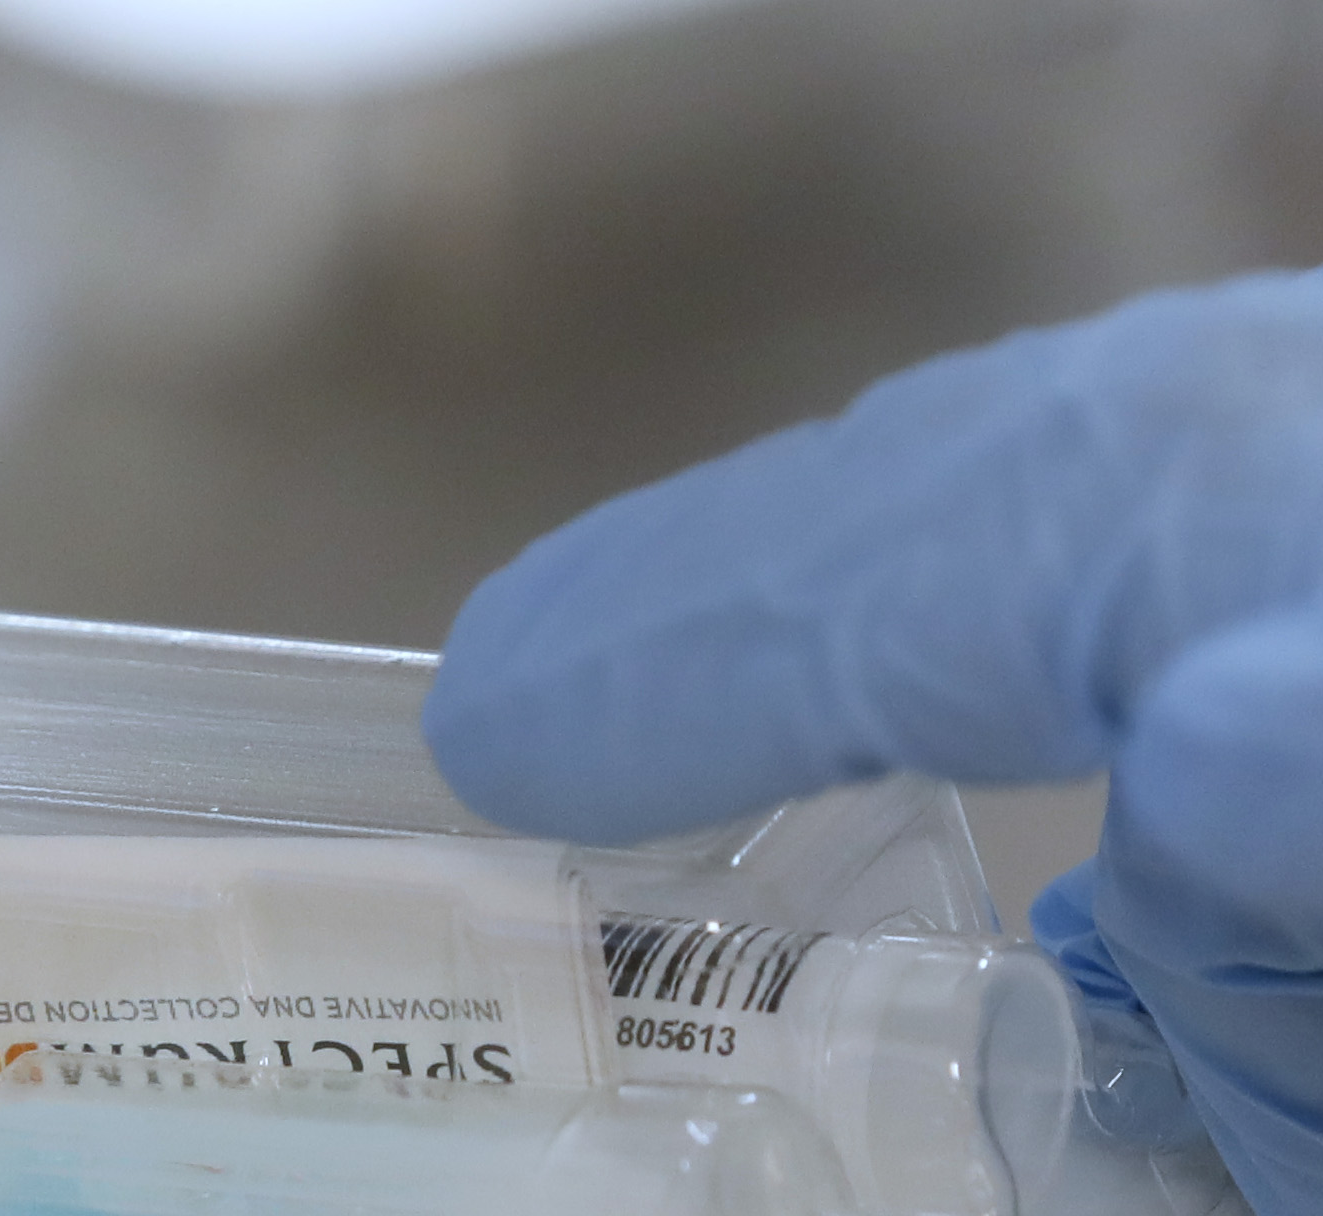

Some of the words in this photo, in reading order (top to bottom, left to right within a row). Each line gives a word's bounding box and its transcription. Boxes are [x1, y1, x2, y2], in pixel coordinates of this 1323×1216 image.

[45, 997, 240, 1022] COLLECTION
[248, 995, 315, 1018] DNA
[322, 997, 503, 1023] INNOVATIVE
[615, 1016, 737, 1057] 805613
